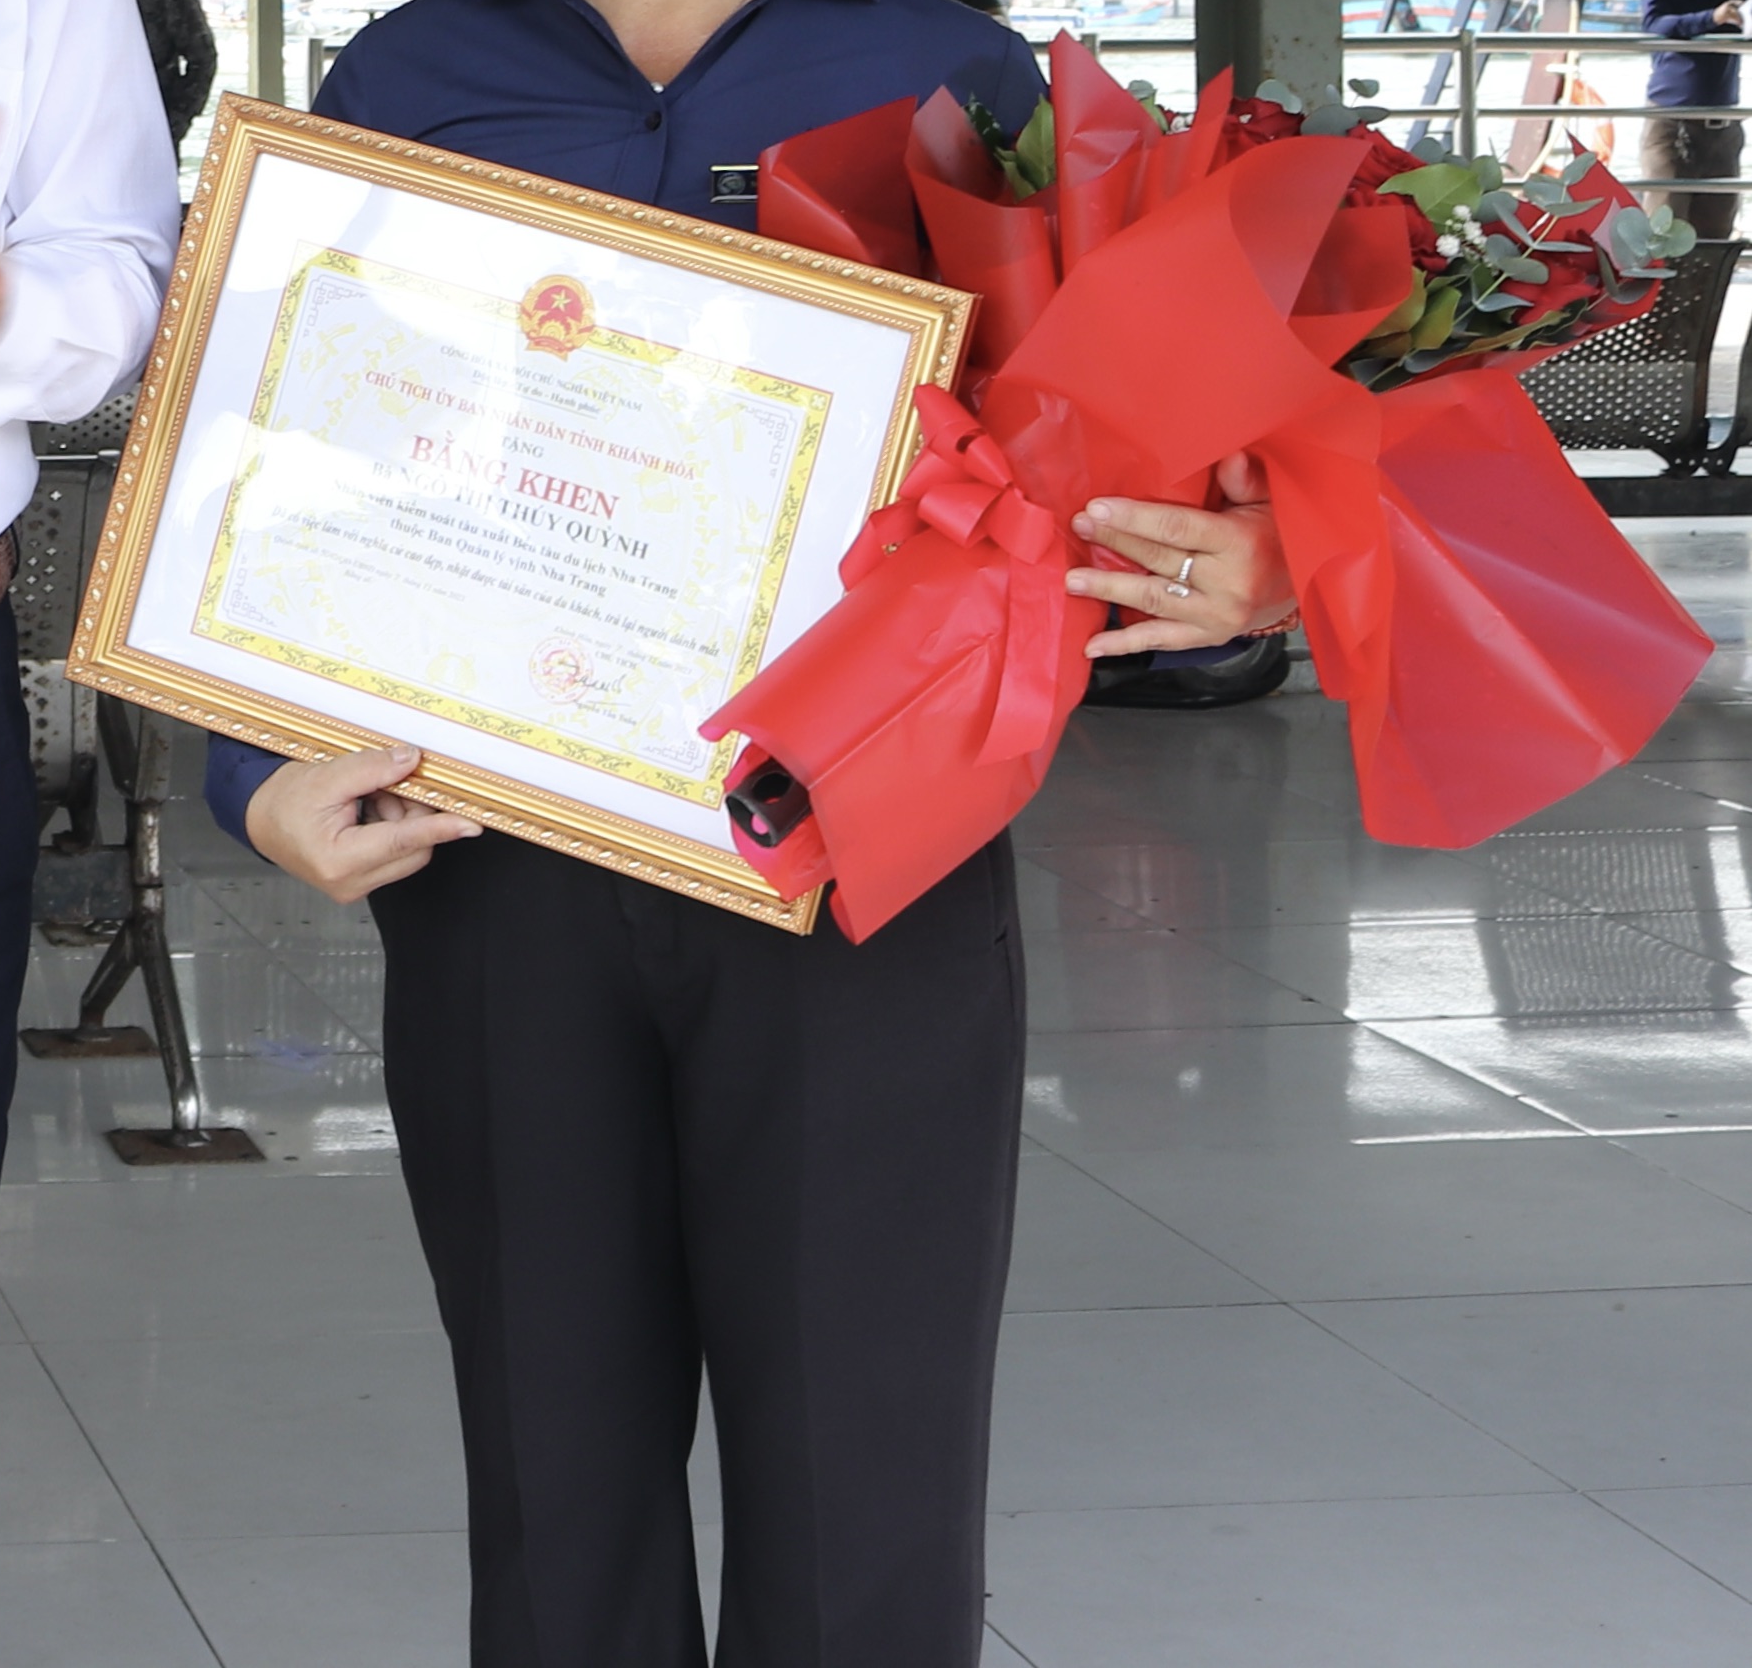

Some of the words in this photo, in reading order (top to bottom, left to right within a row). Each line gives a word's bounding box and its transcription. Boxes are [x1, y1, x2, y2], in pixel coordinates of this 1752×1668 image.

[364, 370, 397, 390] CHỦ
[398, 379, 433, 402] TỊCH
[435, 387, 456, 408] ỦY
[533, 420, 567, 441] DÂN
[568, 428, 606, 453] TỈNH
[606, 442, 661, 470] KHÁNH
[661, 459, 696, 481] HÒA
[409, 430, 507, 486] BẰNG
[515, 468, 620, 520] KHEN
[390, 518, 424, 538] thuộc
[427, 528, 452, 546] Ban
[455, 538, 490, 558] Quản
[493, 549, 504, 565] lý
[508, 557, 536, 573] vịnh
[541, 564, 565, 582] Nha
[570, 573, 607, 598] Trang
